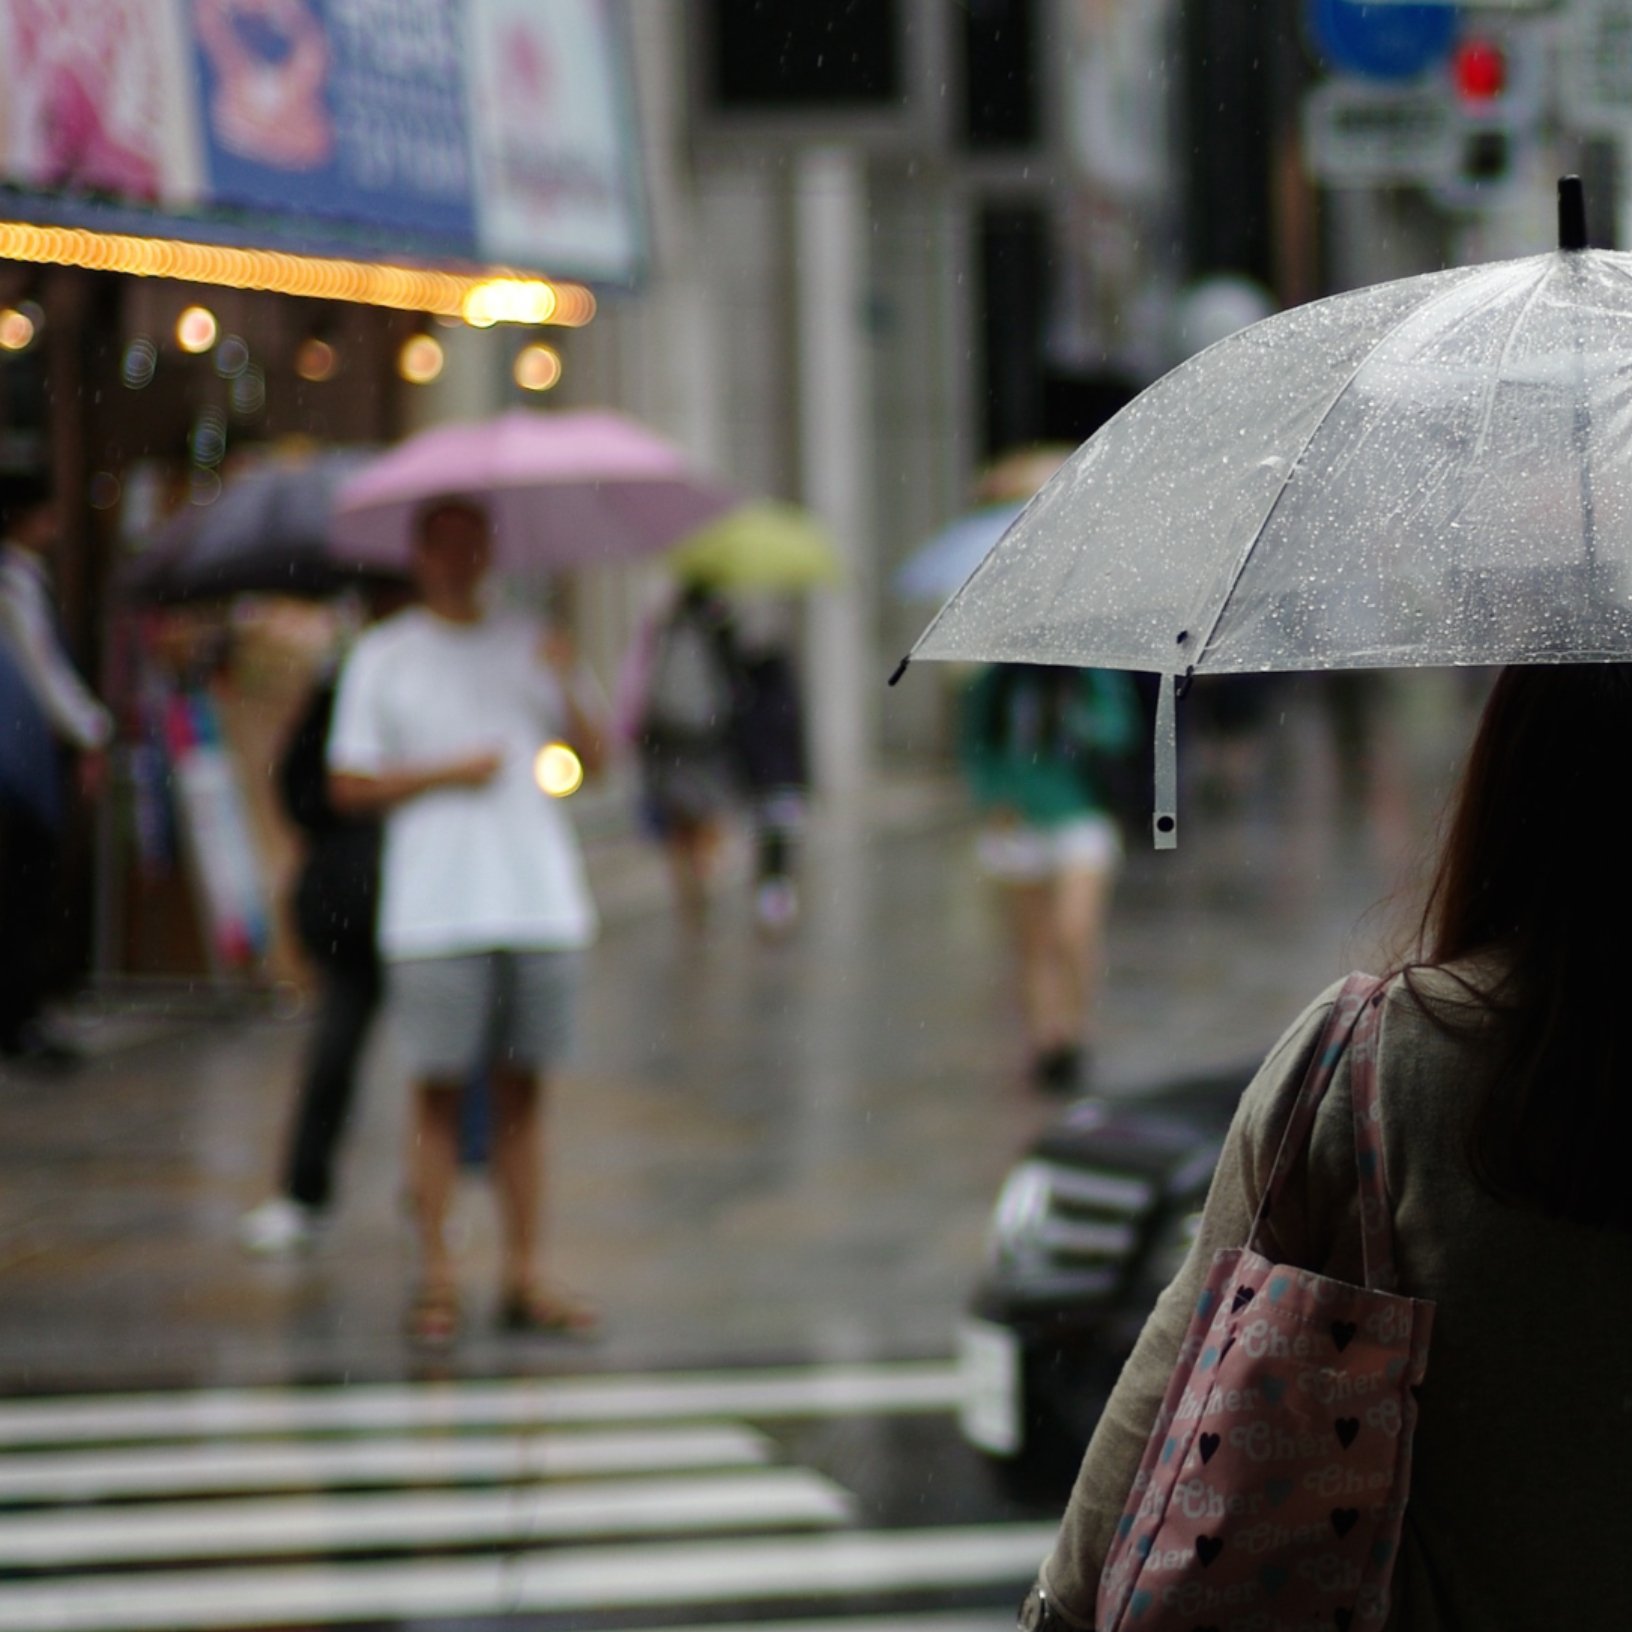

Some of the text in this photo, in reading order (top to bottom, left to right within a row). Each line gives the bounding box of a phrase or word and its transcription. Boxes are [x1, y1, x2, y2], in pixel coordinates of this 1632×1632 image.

[1367, 1304, 1411, 1344] Ch
[1202, 1387, 1260, 1415] her
[1297, 1367, 1381, 1405] Cher
[1229, 1420, 1332, 1462] Cher
[1173, 1477, 1263, 1519] Cher
[1232, 1523, 1330, 1554] Cher
[1143, 1549, 1193, 1570] her
[1297, 1553, 1362, 1592] Ch
[1163, 1581, 1260, 1616] Cher
